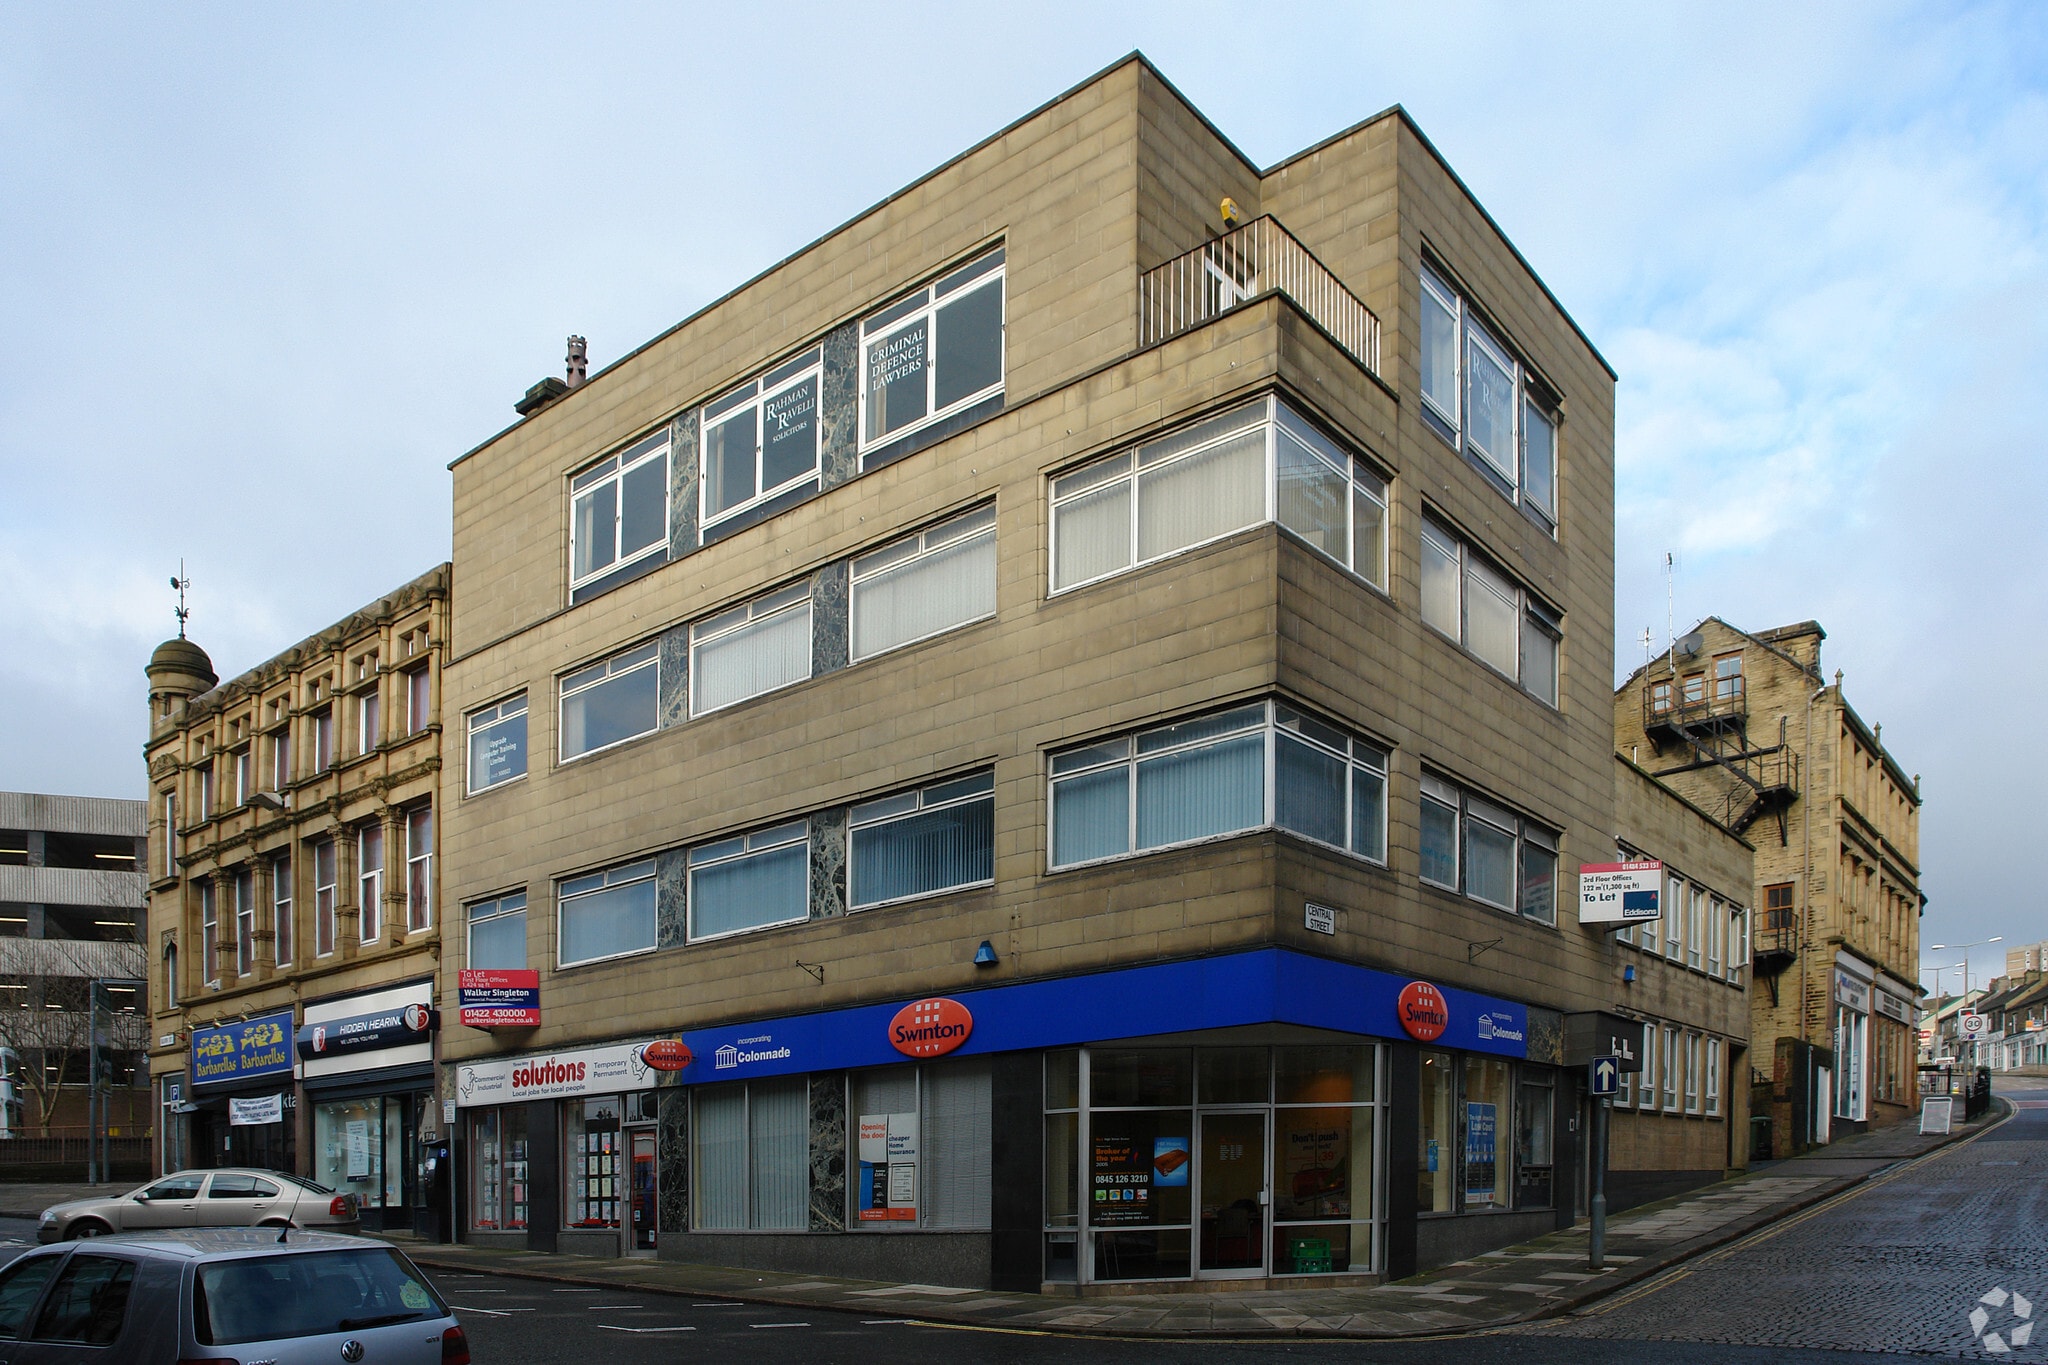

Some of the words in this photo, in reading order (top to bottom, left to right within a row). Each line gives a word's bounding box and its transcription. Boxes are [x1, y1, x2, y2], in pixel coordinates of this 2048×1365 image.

[870, 328, 925, 364] CRIMINAL
[872, 343, 923, 378] DEFENCE
[873, 357, 922, 391] LAWYERS
[766, 385, 809, 421] RAHMAN
[777, 398, 815, 431] RAVELLI
[772, 421, 807, 443] SOLICITORS
[1583, 893, 1596, 903] To
[1599, 893, 1616, 902] Let
[1308, 905, 1332, 921] CENTRAL
[1624, 908, 1657, 916] Eddisons
[1310, 918, 1330, 932] STREET
[462, 970, 472, 978] To
[473, 970, 485, 978] Let
[464, 988, 491, 997] Walker
[492, 988, 530, 998] Singleton
[464, 1009, 490, 1018] 01422
[492, 1009, 526, 1018] 430000
[465, 1017, 533, 1025] walkersingleton.co.uk
[339, 1021, 368, 1035] HIDDEN
[895, 1022, 965, 1045] Swinton
[1492, 1025, 1523, 1041] Colonnade
[737, 1034, 772, 1046] incorporating
[241, 1047, 286, 1070] Barbarellas
[648, 1050, 691, 1063] Swinton
[737, 1046, 791, 1064] Colonnade
[196, 1056, 237, 1078] Barbarellas
[512, 1056, 587, 1088] solutions
[593, 1060, 628, 1072] Temporary
[474, 1073, 506, 1083] Commercial
[593, 1068, 628, 1079] Permanent
[477, 1082, 503, 1091] Industrial
[512, 1088, 527, 1097] Local
[527, 1088, 540, 1097] jobs
[550, 1085, 565, 1093] local
[565, 1084, 586, 1093] people
[861, 1123, 886, 1131] Opening
[1318, 1130, 1339, 1143] push
[440, 1148, 447, 1158] P
[1110, 1155, 1127, 1163] year
[1095, 1175, 1114, 1184] 0845
[1115, 1175, 1129, 1183] 126
[1130, 1174, 1149, 1183] 3210
